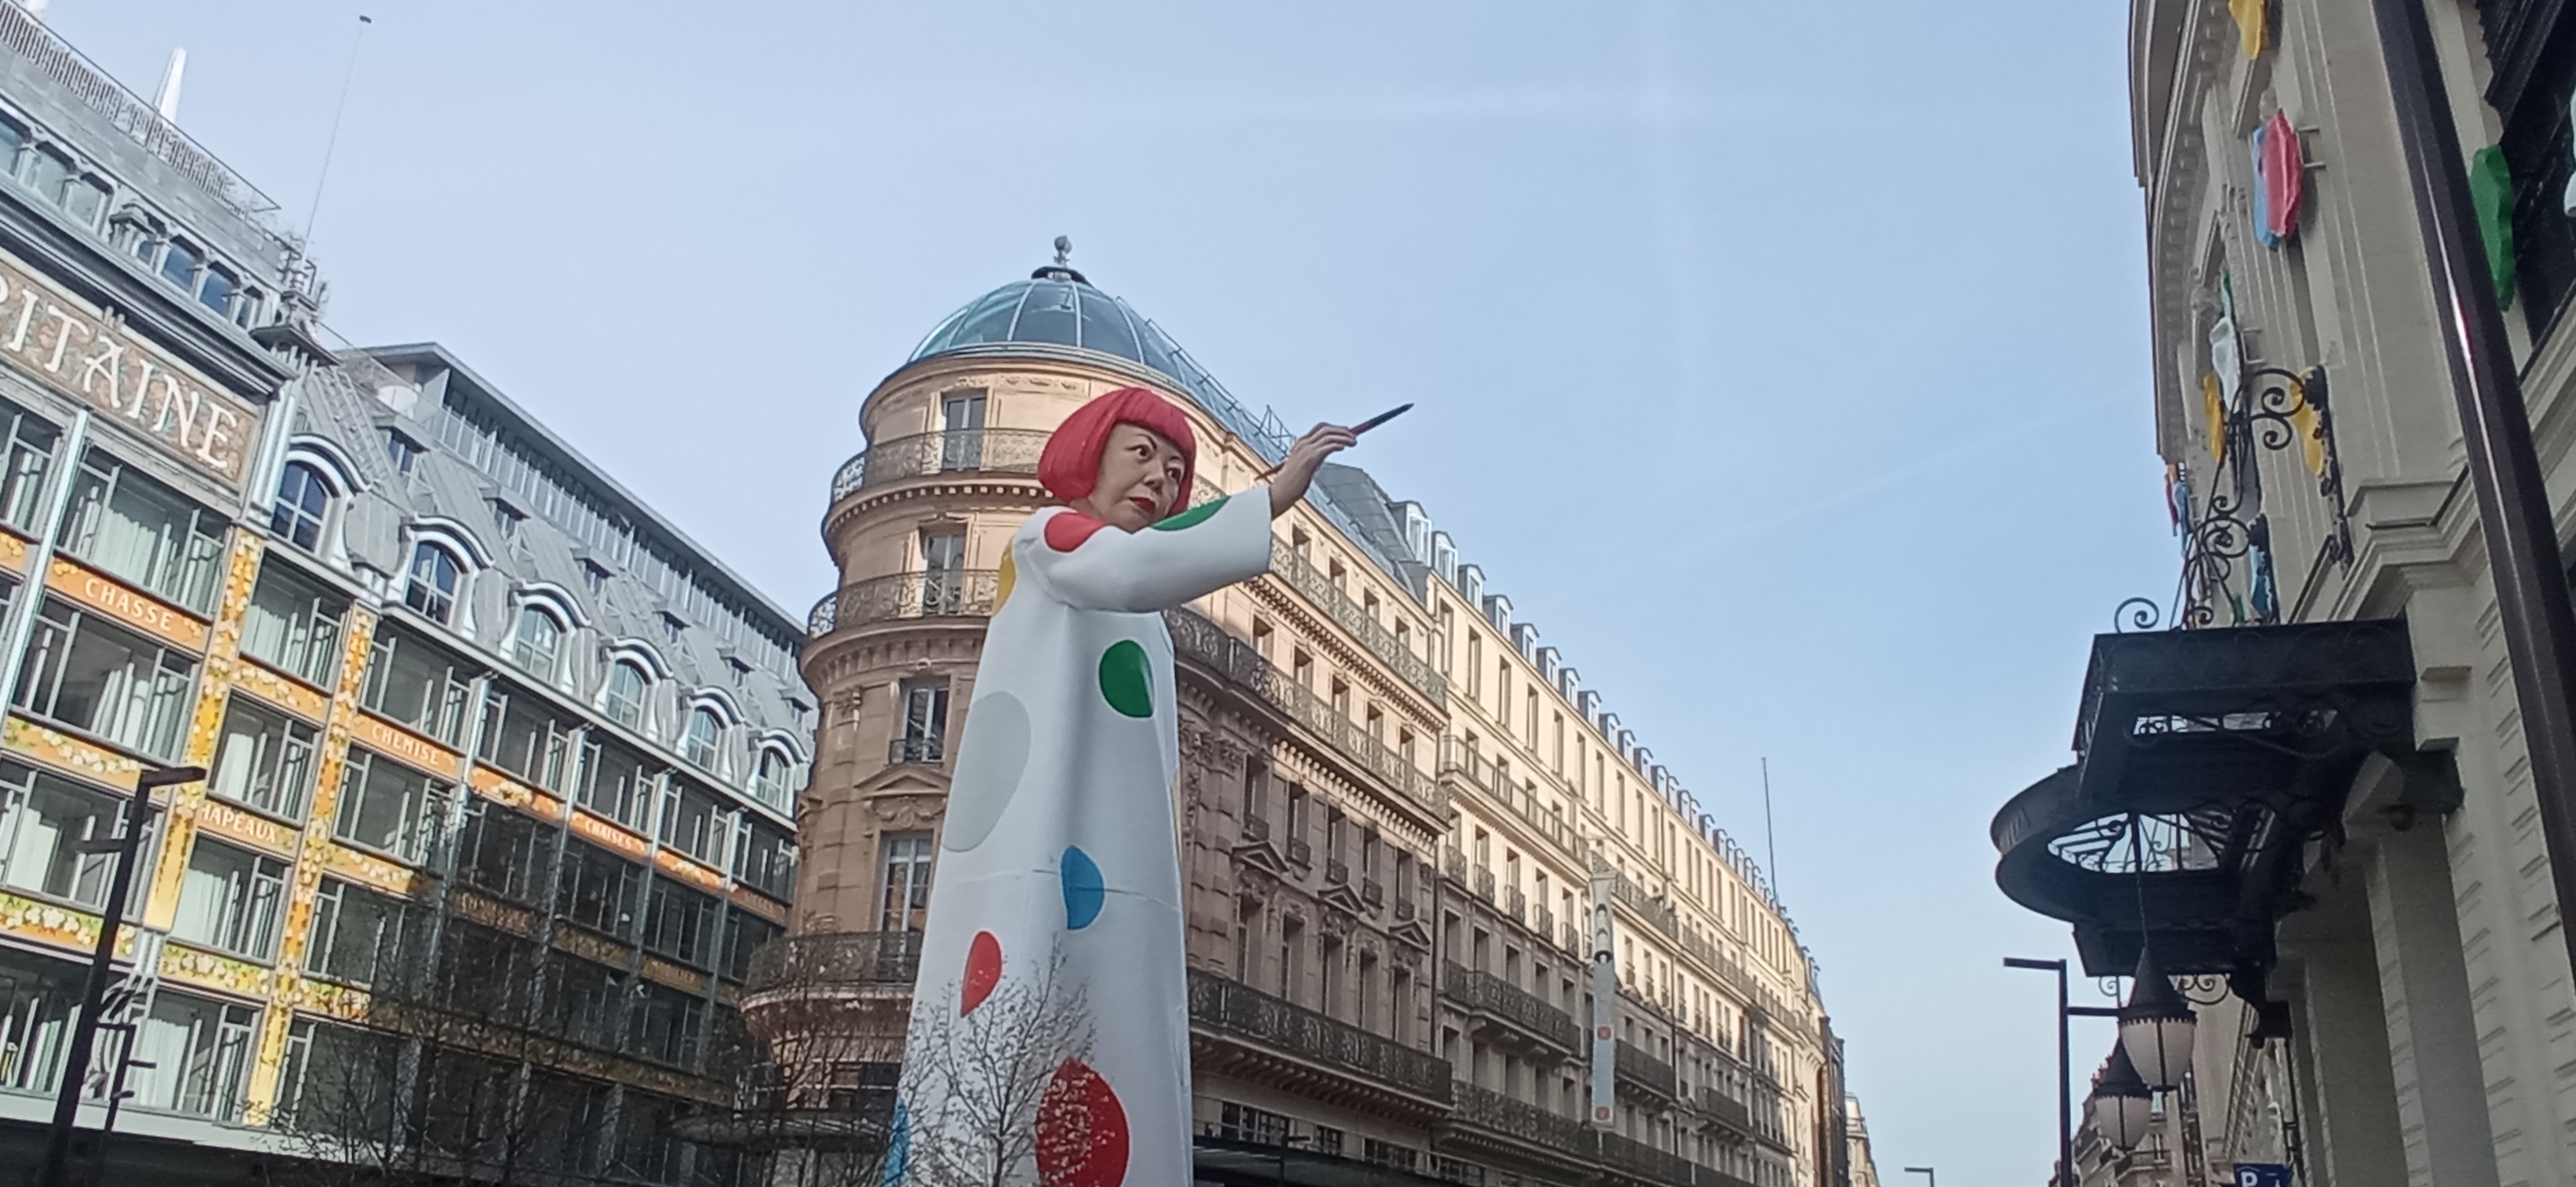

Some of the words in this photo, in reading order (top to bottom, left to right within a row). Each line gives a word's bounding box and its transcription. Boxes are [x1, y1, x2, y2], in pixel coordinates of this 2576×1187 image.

[0, 274, 237, 468] ITAINE
[84, 577, 175, 631] CHASSE
[371, 723, 439, 766] CHEMISE
[200, 803, 276, 844] HAPEAUX
[2241, 1170, 2258, 1187] P
